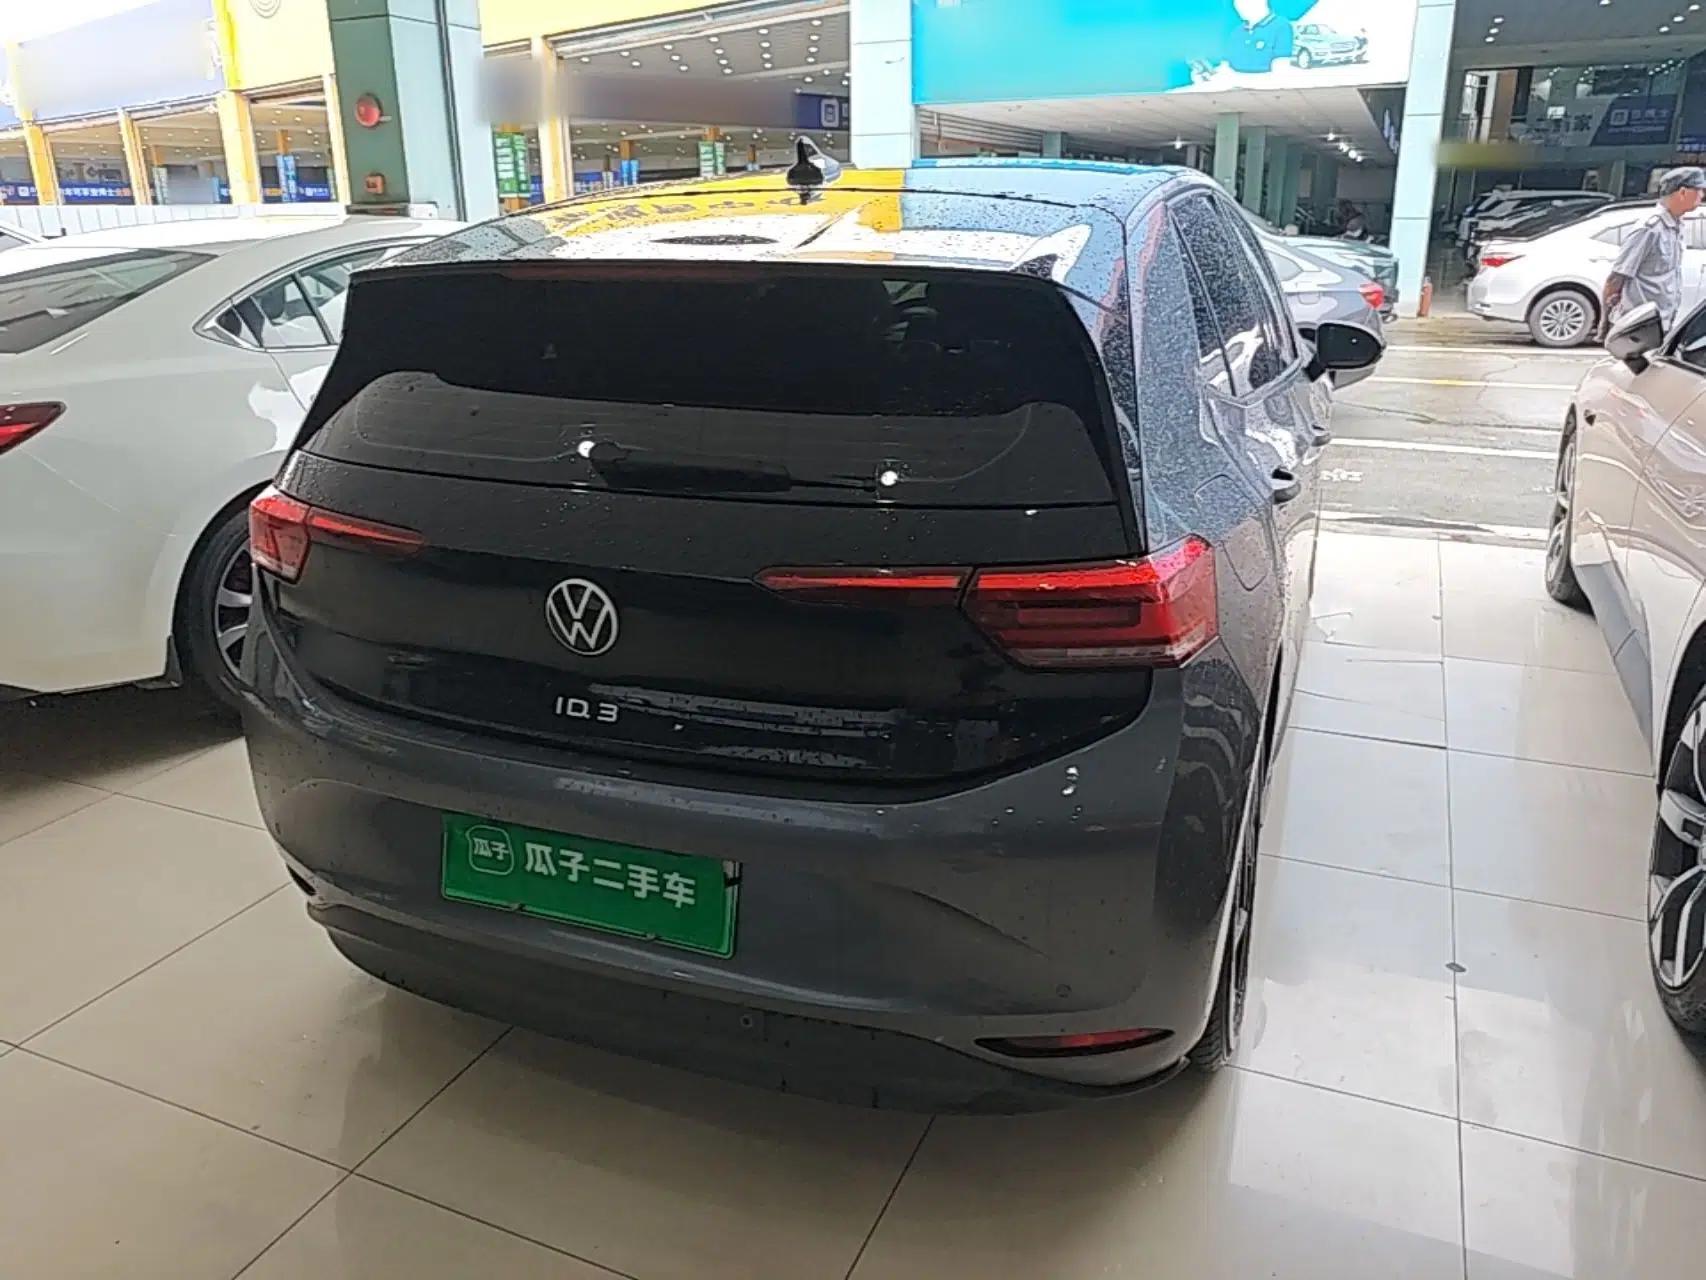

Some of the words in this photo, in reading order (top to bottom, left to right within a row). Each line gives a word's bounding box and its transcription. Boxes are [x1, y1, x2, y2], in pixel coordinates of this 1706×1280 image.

[473, 837, 510, 860] 瓜子
[524, 842, 696, 909] 瓜子二手车
